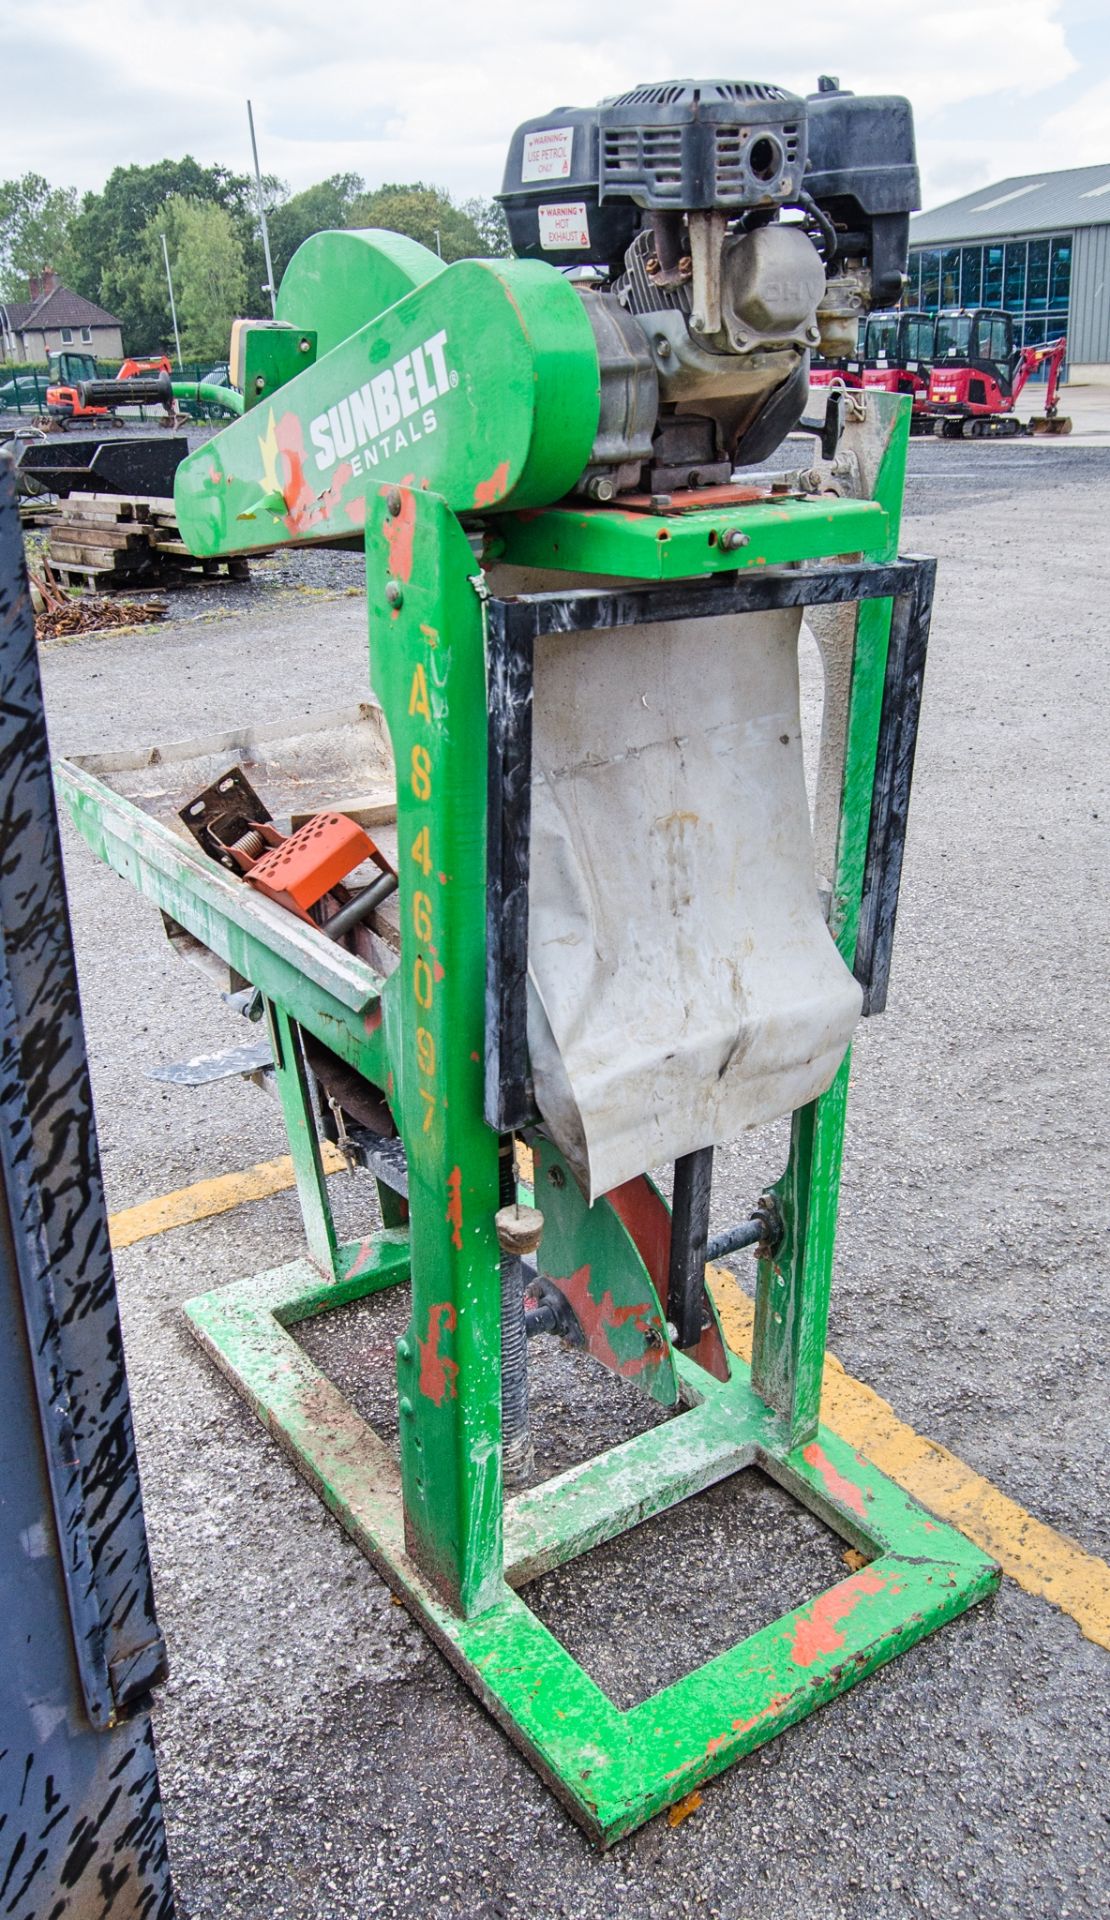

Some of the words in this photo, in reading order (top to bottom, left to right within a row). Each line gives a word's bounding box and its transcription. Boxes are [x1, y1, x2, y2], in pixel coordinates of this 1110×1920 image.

[533, 133, 564, 145] WARNING
[528, 150, 541, 162] USE
[541, 147, 567, 160] PETROL
[546, 207, 577, 217] WARNING
[555, 218, 569, 229] HOT
[548, 230, 578, 242] EXHAUST
[350, 408, 438, 477] ENTALS
